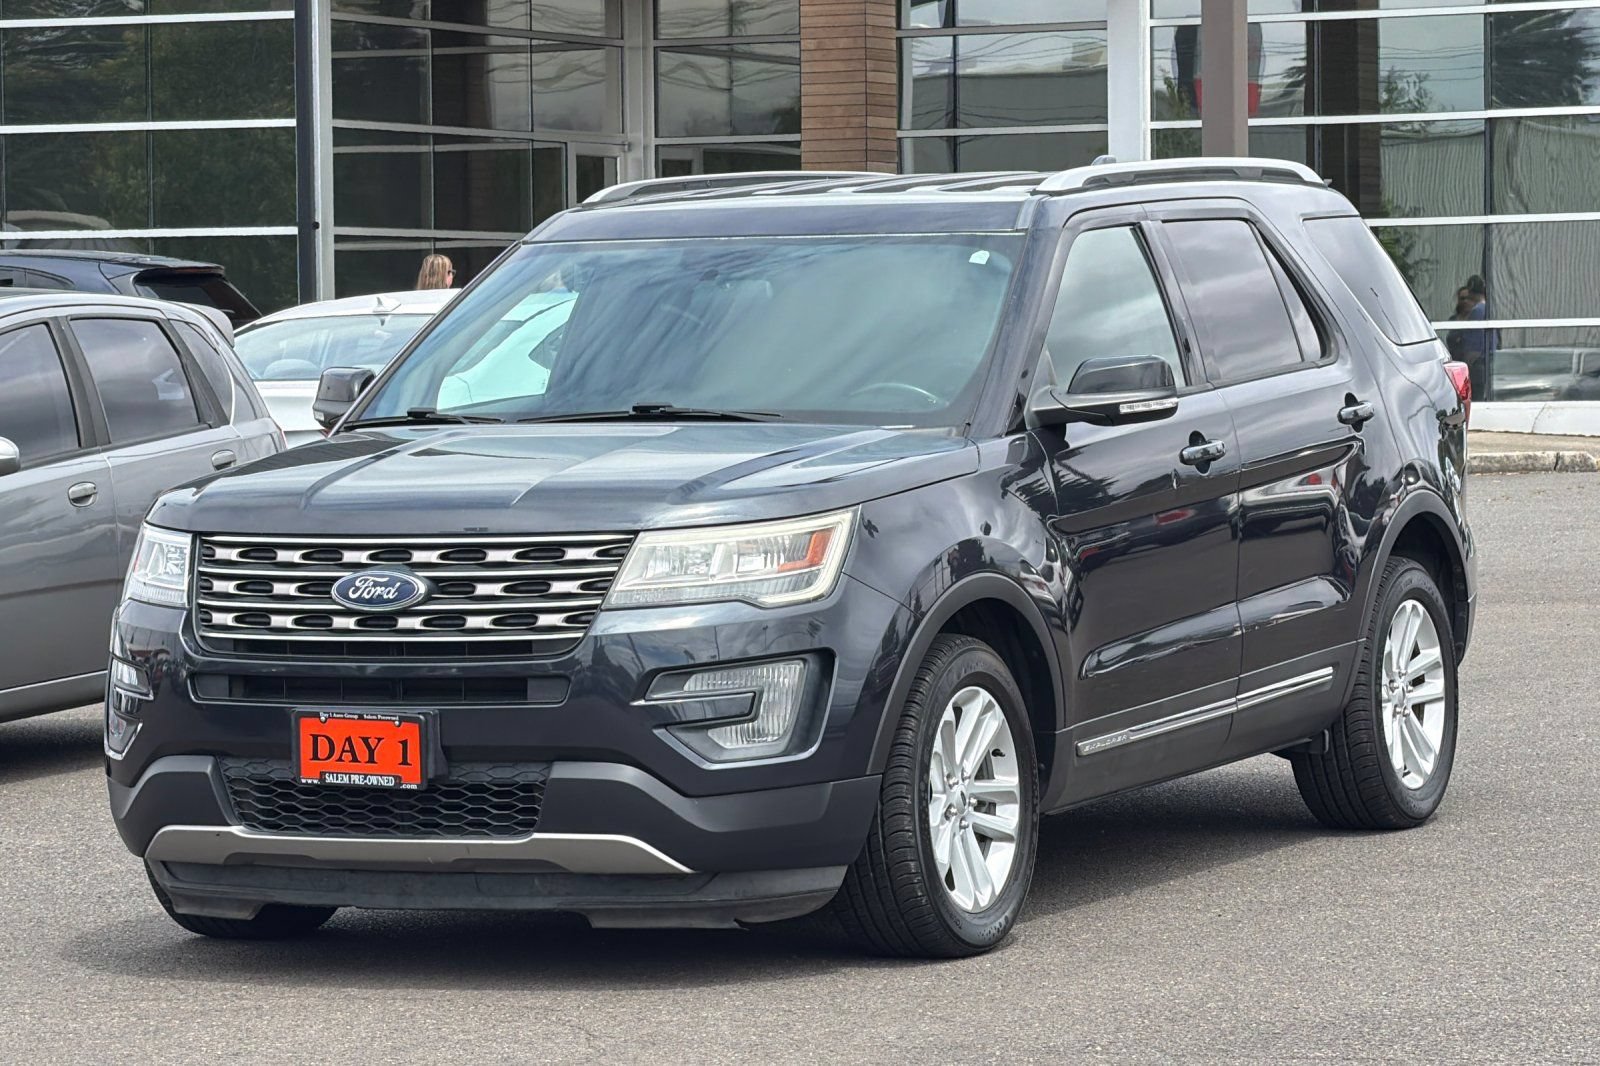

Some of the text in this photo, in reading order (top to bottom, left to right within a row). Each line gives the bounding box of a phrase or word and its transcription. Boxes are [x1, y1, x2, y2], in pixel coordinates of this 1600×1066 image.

[348, 576, 401, 599] Ford
[309, 733, 413, 766] DAY 1
[325, 773, 349, 784] SALEM
[350, 774, 395, 787] PRE-OWNED
